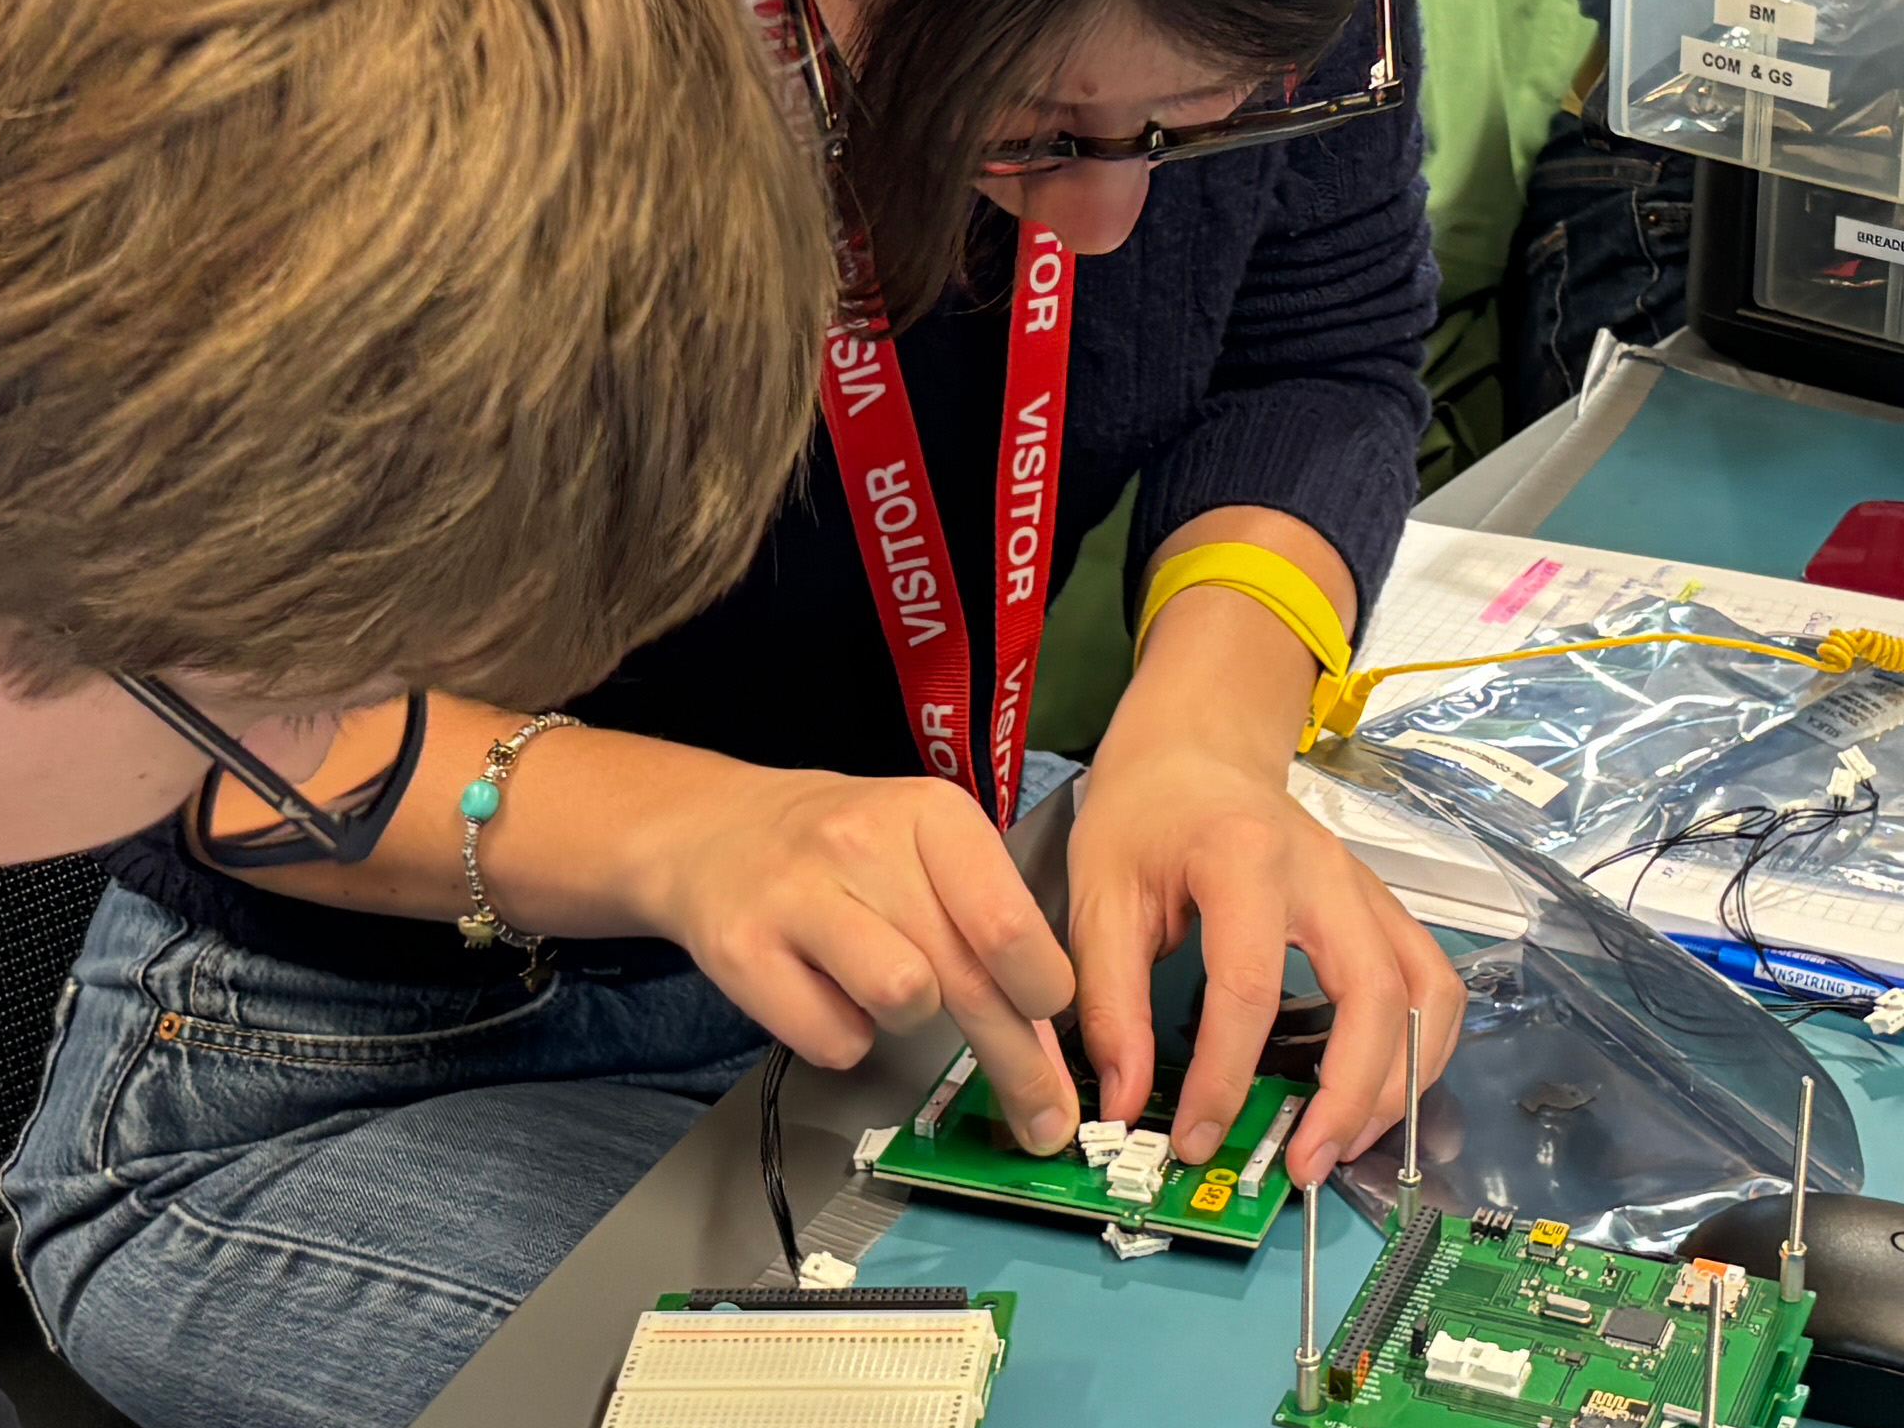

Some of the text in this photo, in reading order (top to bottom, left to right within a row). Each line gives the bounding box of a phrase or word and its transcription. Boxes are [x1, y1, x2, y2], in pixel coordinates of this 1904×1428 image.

[1749, 3, 1777, 24] BM
[1701, 52, 1794, 88] COM & GS
[1006, 391, 1052, 606] VISITOR
[865, 458, 948, 647] VISITOR
[1772, 966, 1846, 994] INSPIRING
